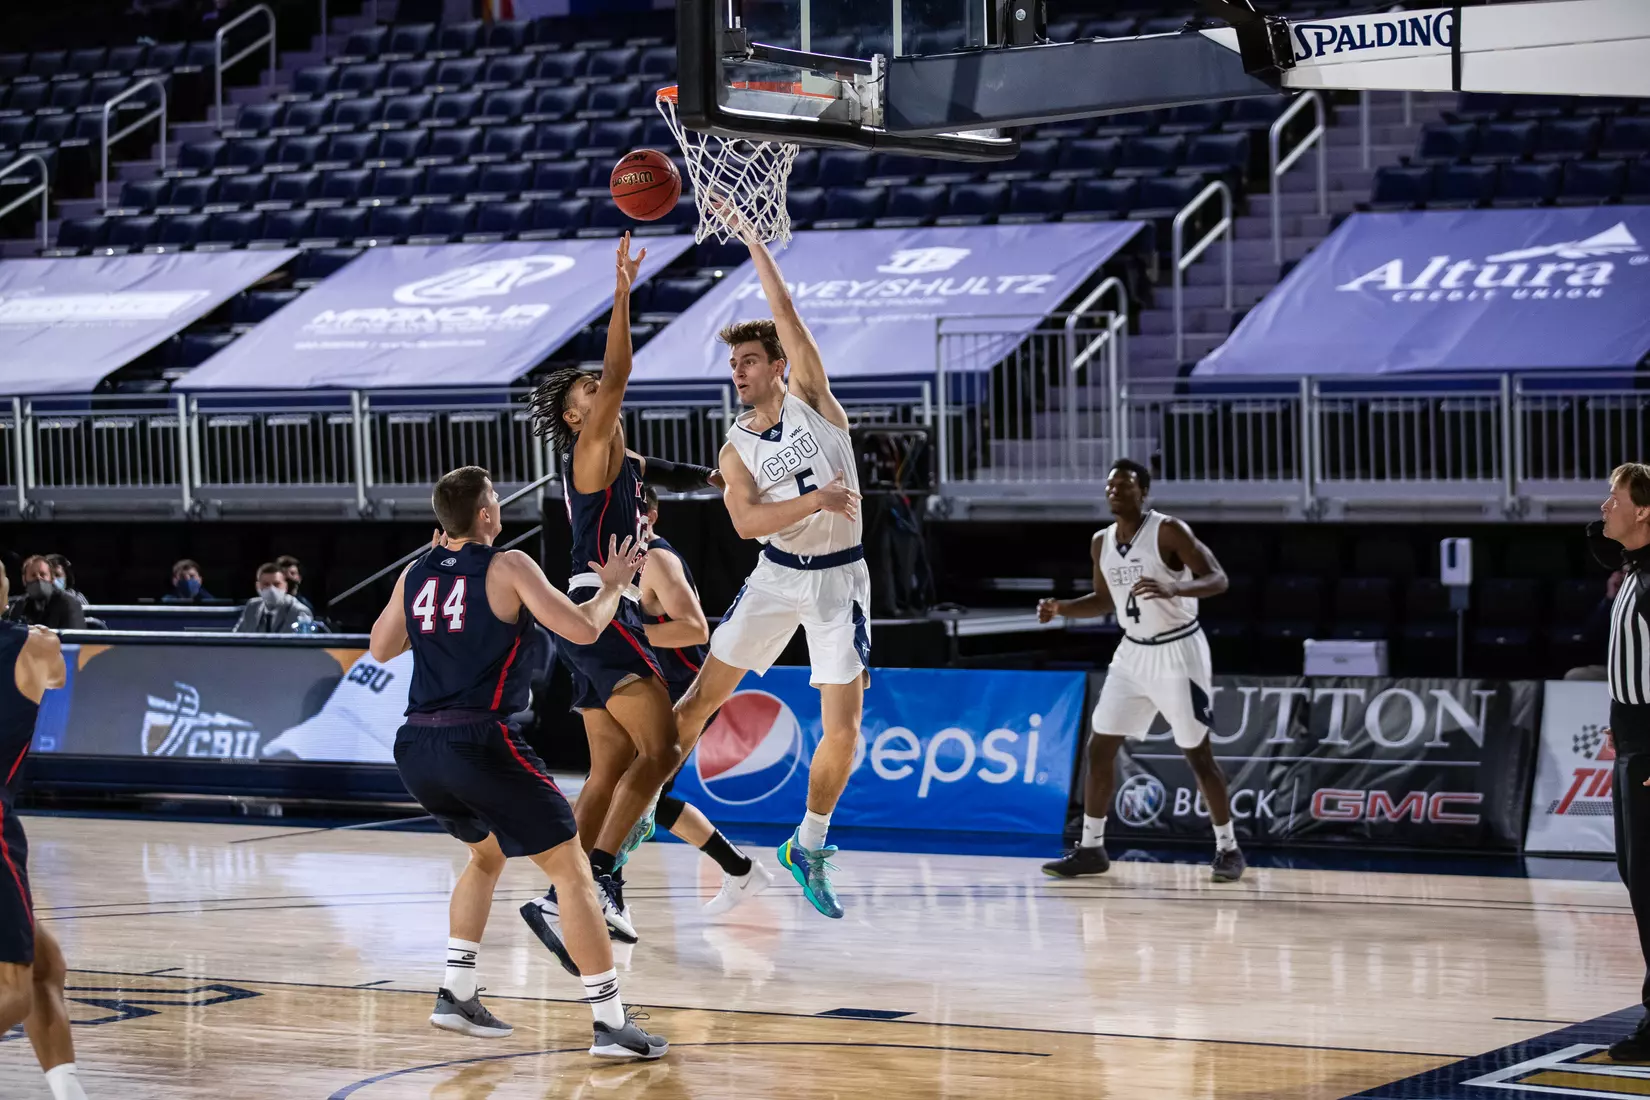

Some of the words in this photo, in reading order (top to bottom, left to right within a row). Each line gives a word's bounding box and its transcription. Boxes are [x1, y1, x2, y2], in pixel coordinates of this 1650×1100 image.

[1294, 10, 1453, 62] SPALDING
[612, 170, 654, 188] Wilson
[1336, 254, 1614, 292] Altura
[1392, 287, 1498, 302] CREDIT
[1511, 286, 1604, 300] UNION
[761, 431, 819, 482] CBU
[794, 467, 822, 514] 5
[411, 575, 467, 634] 44
[1125, 591, 1141, 624] 4
[346, 662, 395, 695] CBU
[1143, 686, 1497, 748] UTTON
[187, 730, 261, 759] CBU
[1173, 787, 1277, 819] BUCK
[1309, 787, 1485, 825] GMC
